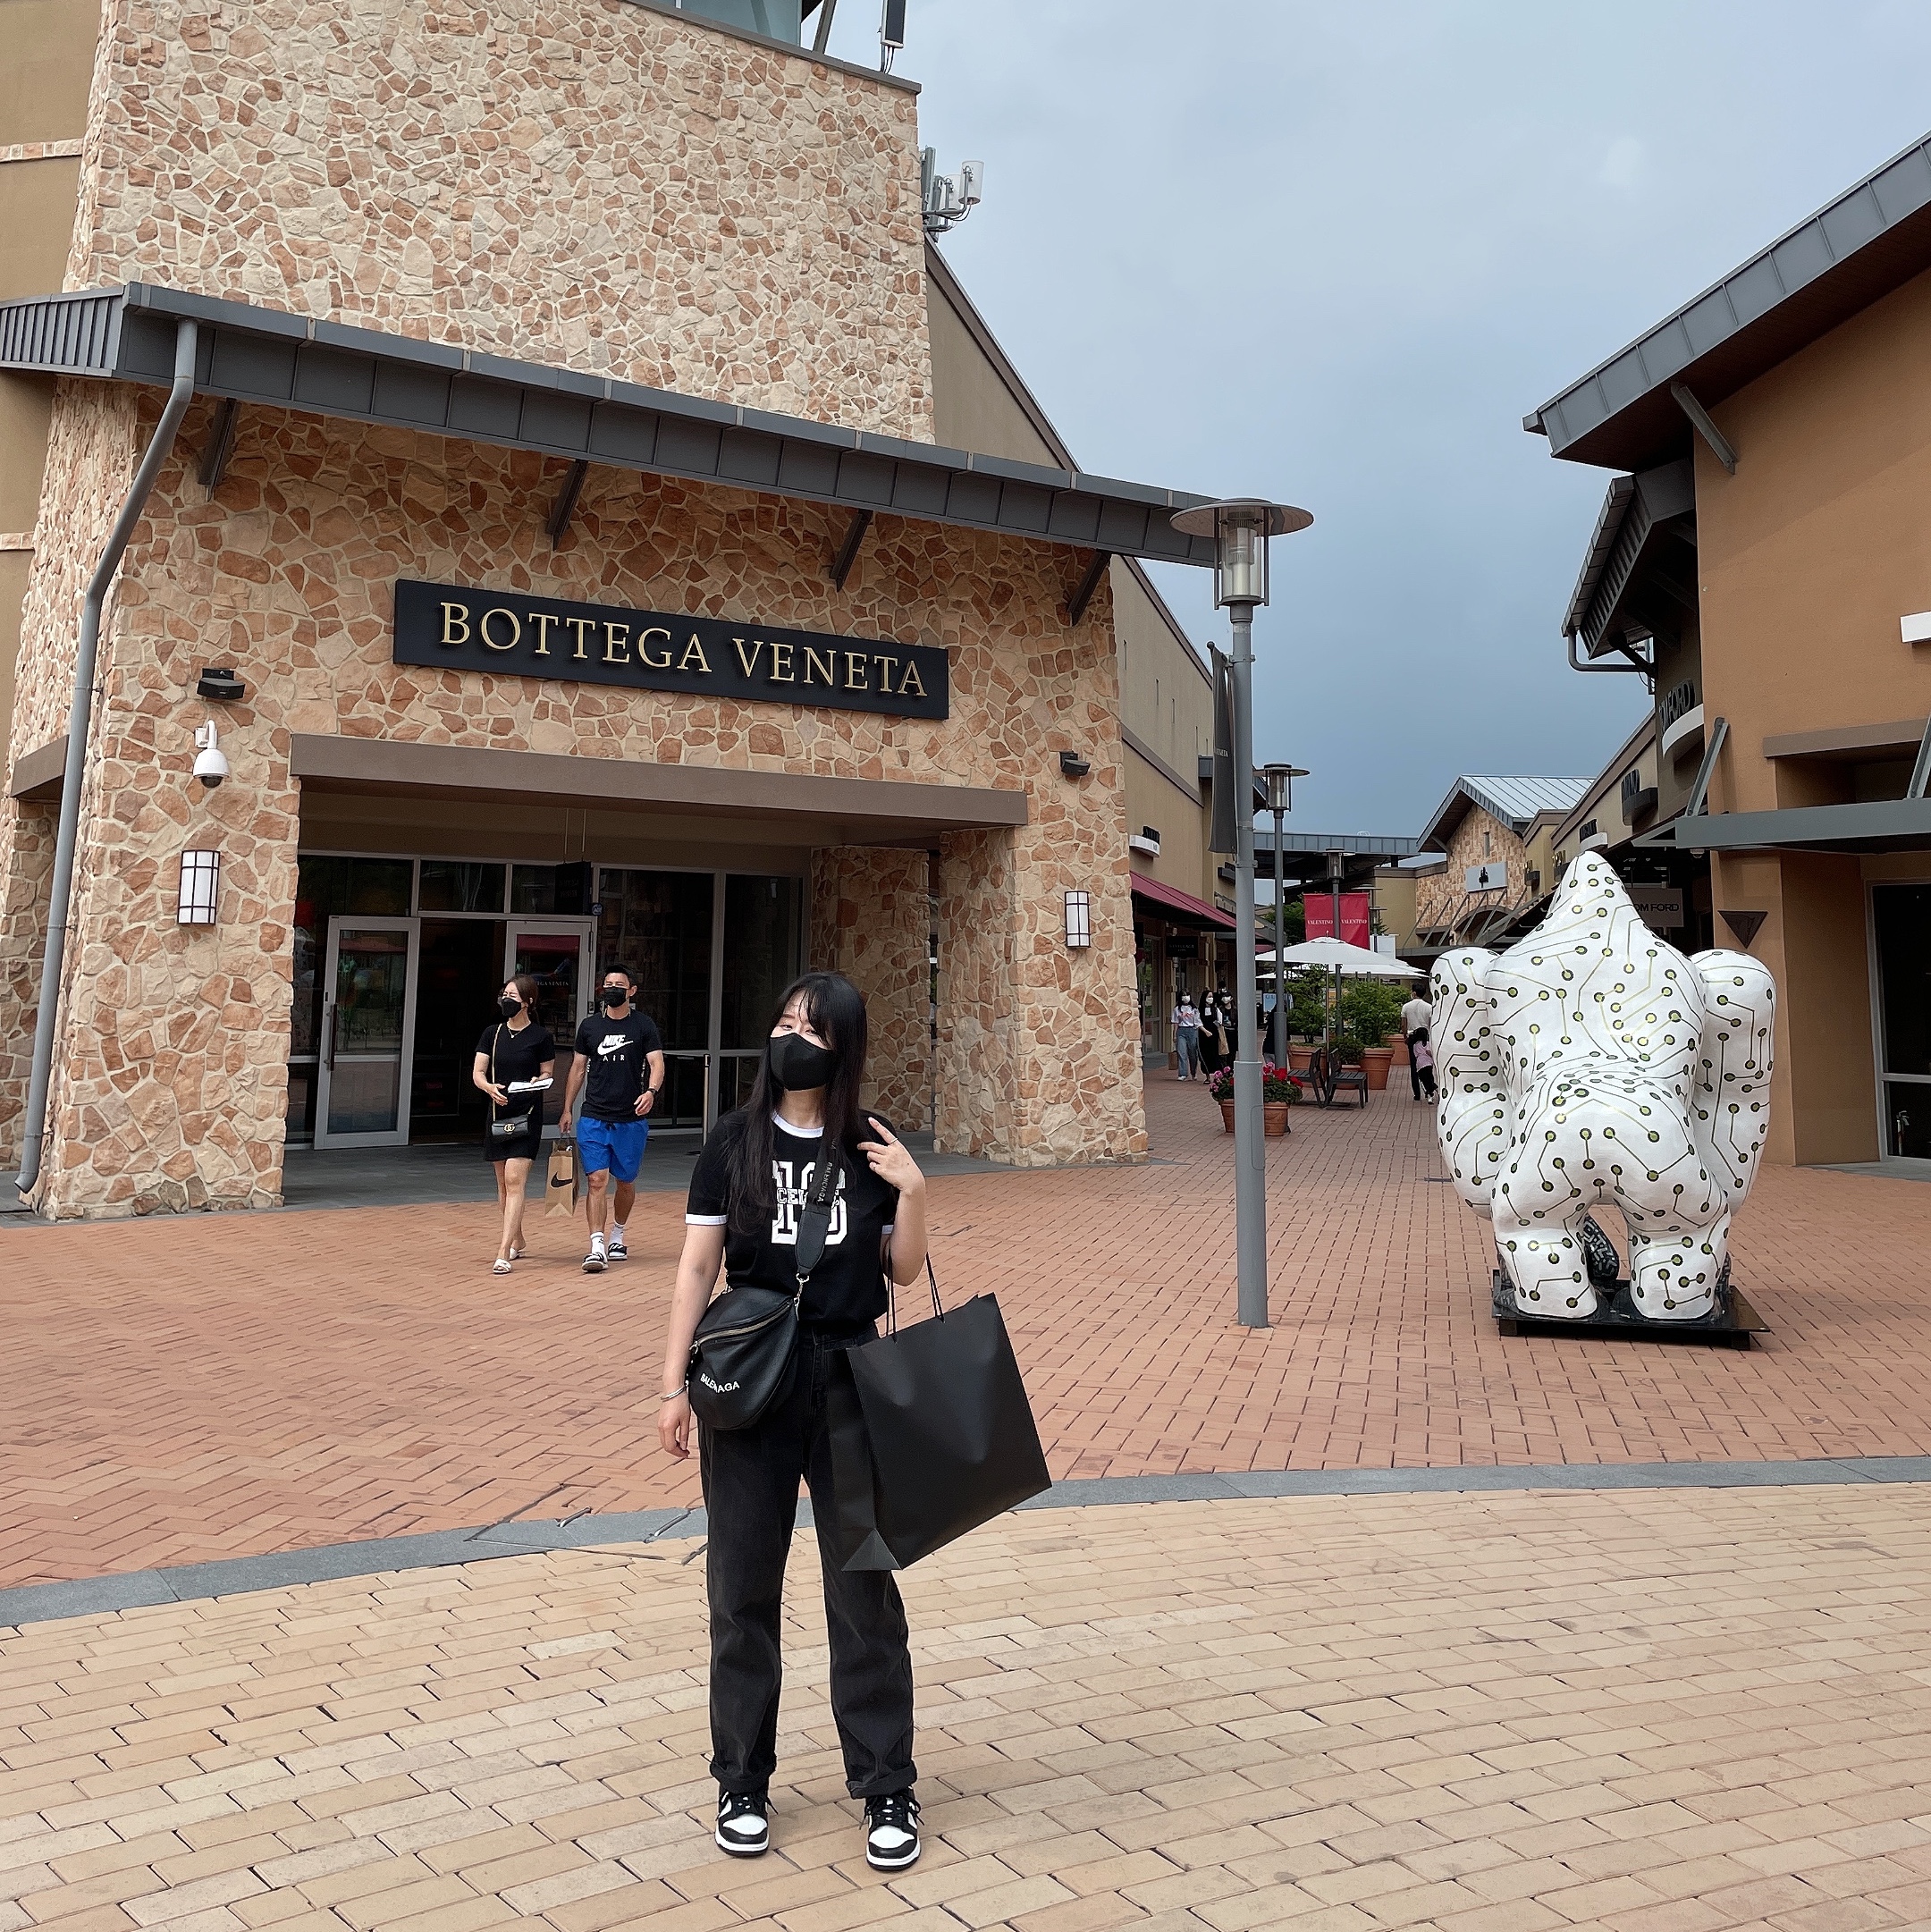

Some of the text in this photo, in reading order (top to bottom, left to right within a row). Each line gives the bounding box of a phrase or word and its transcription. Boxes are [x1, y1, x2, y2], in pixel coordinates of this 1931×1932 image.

[440, 601, 928, 697] BOTTEGA VENETA
[1633, 903, 1680, 912] OM FORD
[602, 1034, 626, 1047] NIKE
